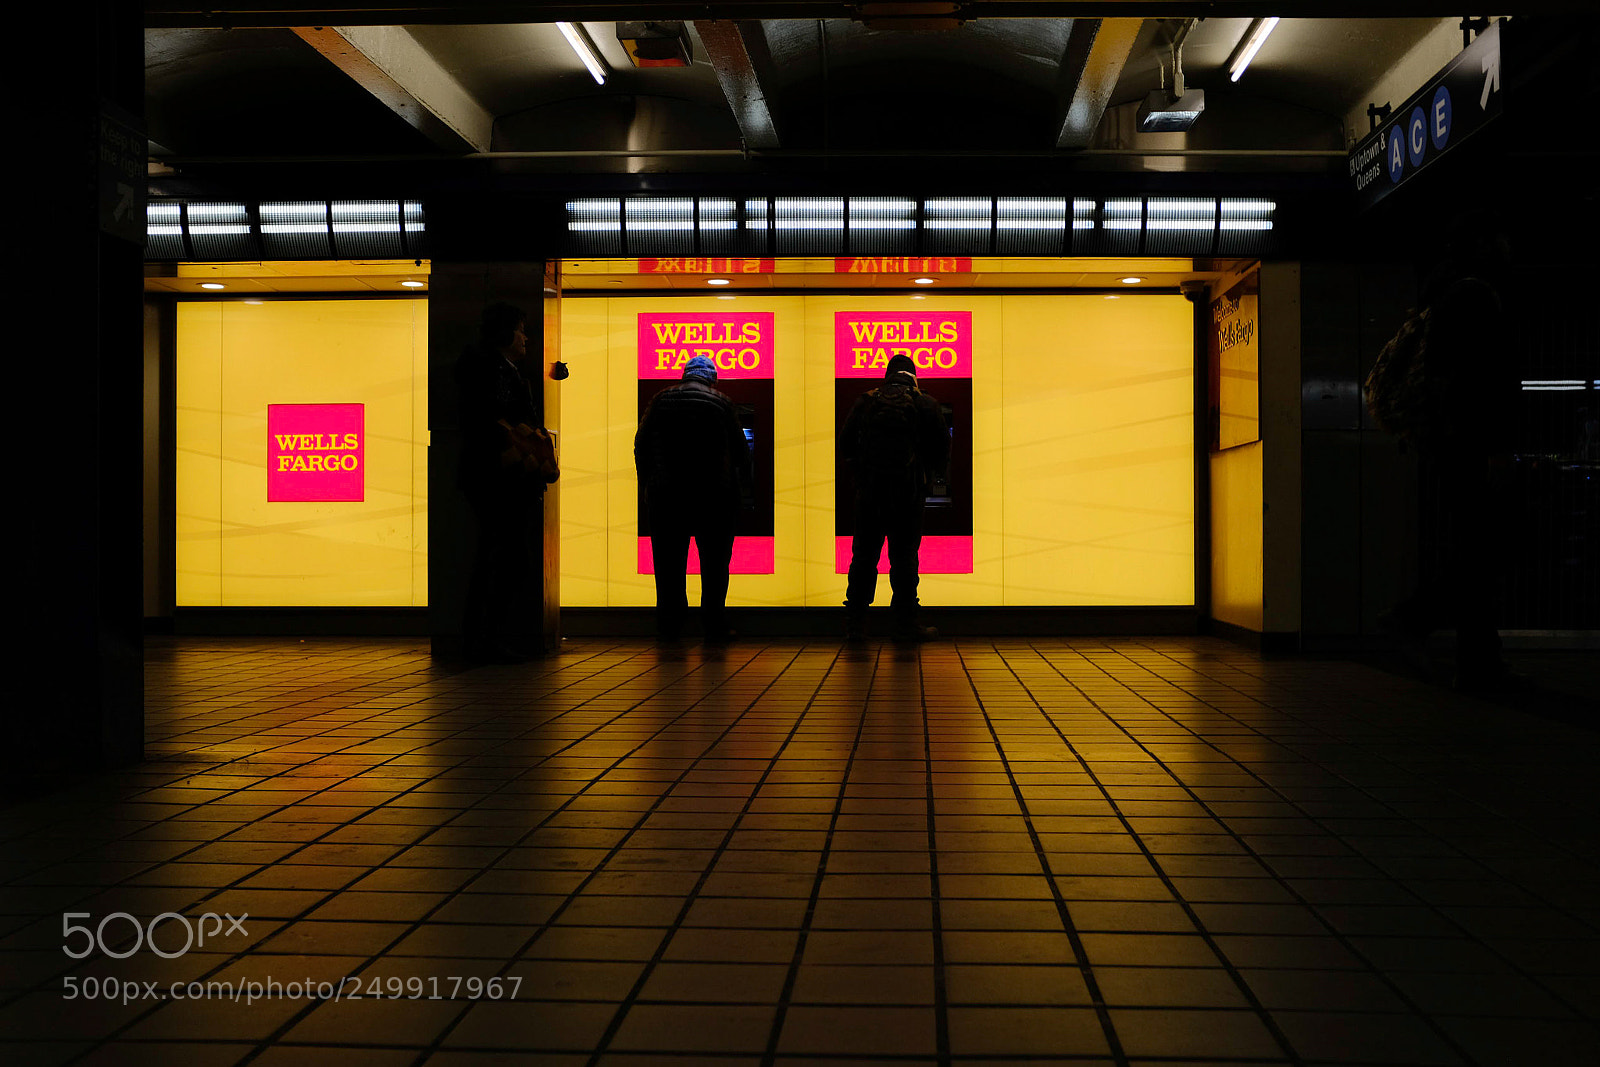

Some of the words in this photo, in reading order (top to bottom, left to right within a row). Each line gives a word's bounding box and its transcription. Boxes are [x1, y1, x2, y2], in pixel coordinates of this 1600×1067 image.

[1355, 142, 1380, 172] Uptown
[1380, 132, 1386, 151] &
[1356, 163, 1380, 191] Queens
[651, 322, 761, 344] WELLS
[848, 321, 957, 343] WELLS
[274, 433, 359, 451] WELLS
[277, 454, 359, 472] FARGO
